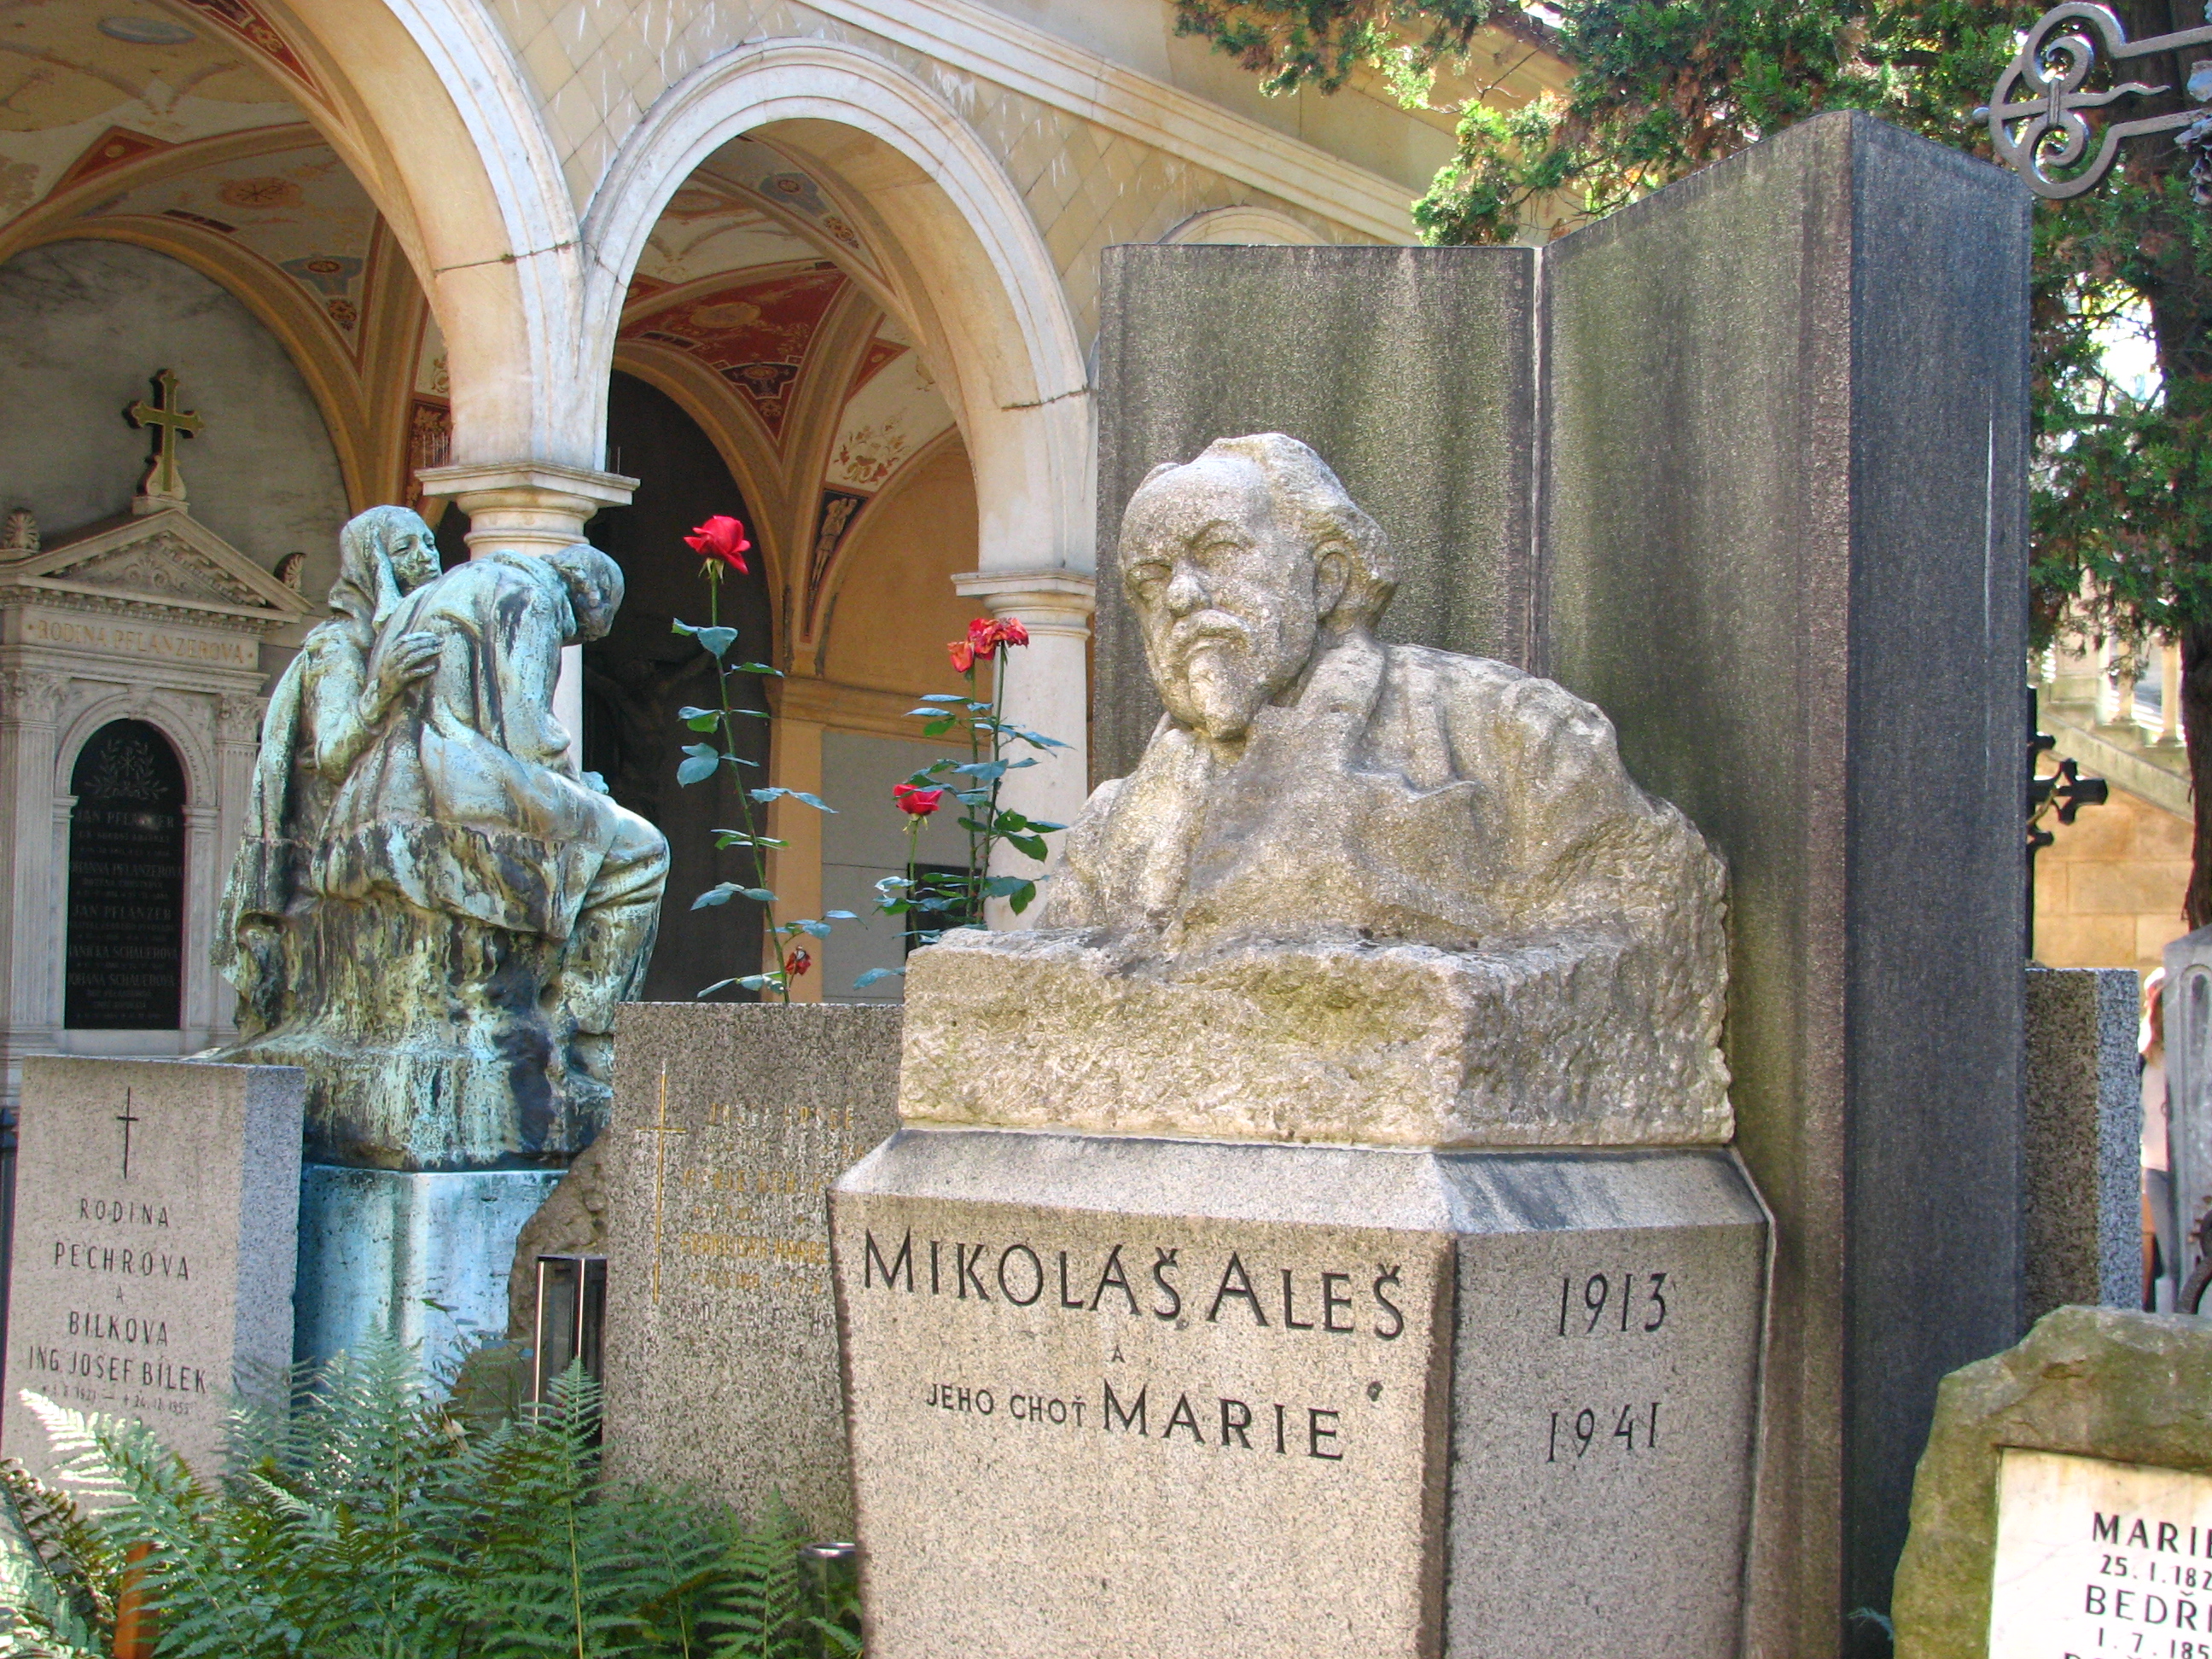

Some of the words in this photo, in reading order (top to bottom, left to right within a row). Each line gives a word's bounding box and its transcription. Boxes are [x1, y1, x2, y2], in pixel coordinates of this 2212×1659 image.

[38, 620, 107, 643] RODINA
[79, 1197, 169, 1227] RODINA
[55, 1242, 189, 1281] PECHROVA
[116, 1285, 124, 1305] A
[864, 1225, 1182, 1321] MIKOLÁŠ
[1206, 1250, 1404, 1341] ALEŠ
[1558, 1272, 1667, 1336] 1913
[69, 1350, 133, 1383] JOSEF
[1110, 1344, 1126, 1364] A
[927, 1382, 994, 1416] JEHO
[1010, 1394, 1086, 1428] CHOŤ
[1103, 1377, 1343, 1461] MARIE
[1546, 1401, 1662, 1464] 1941
